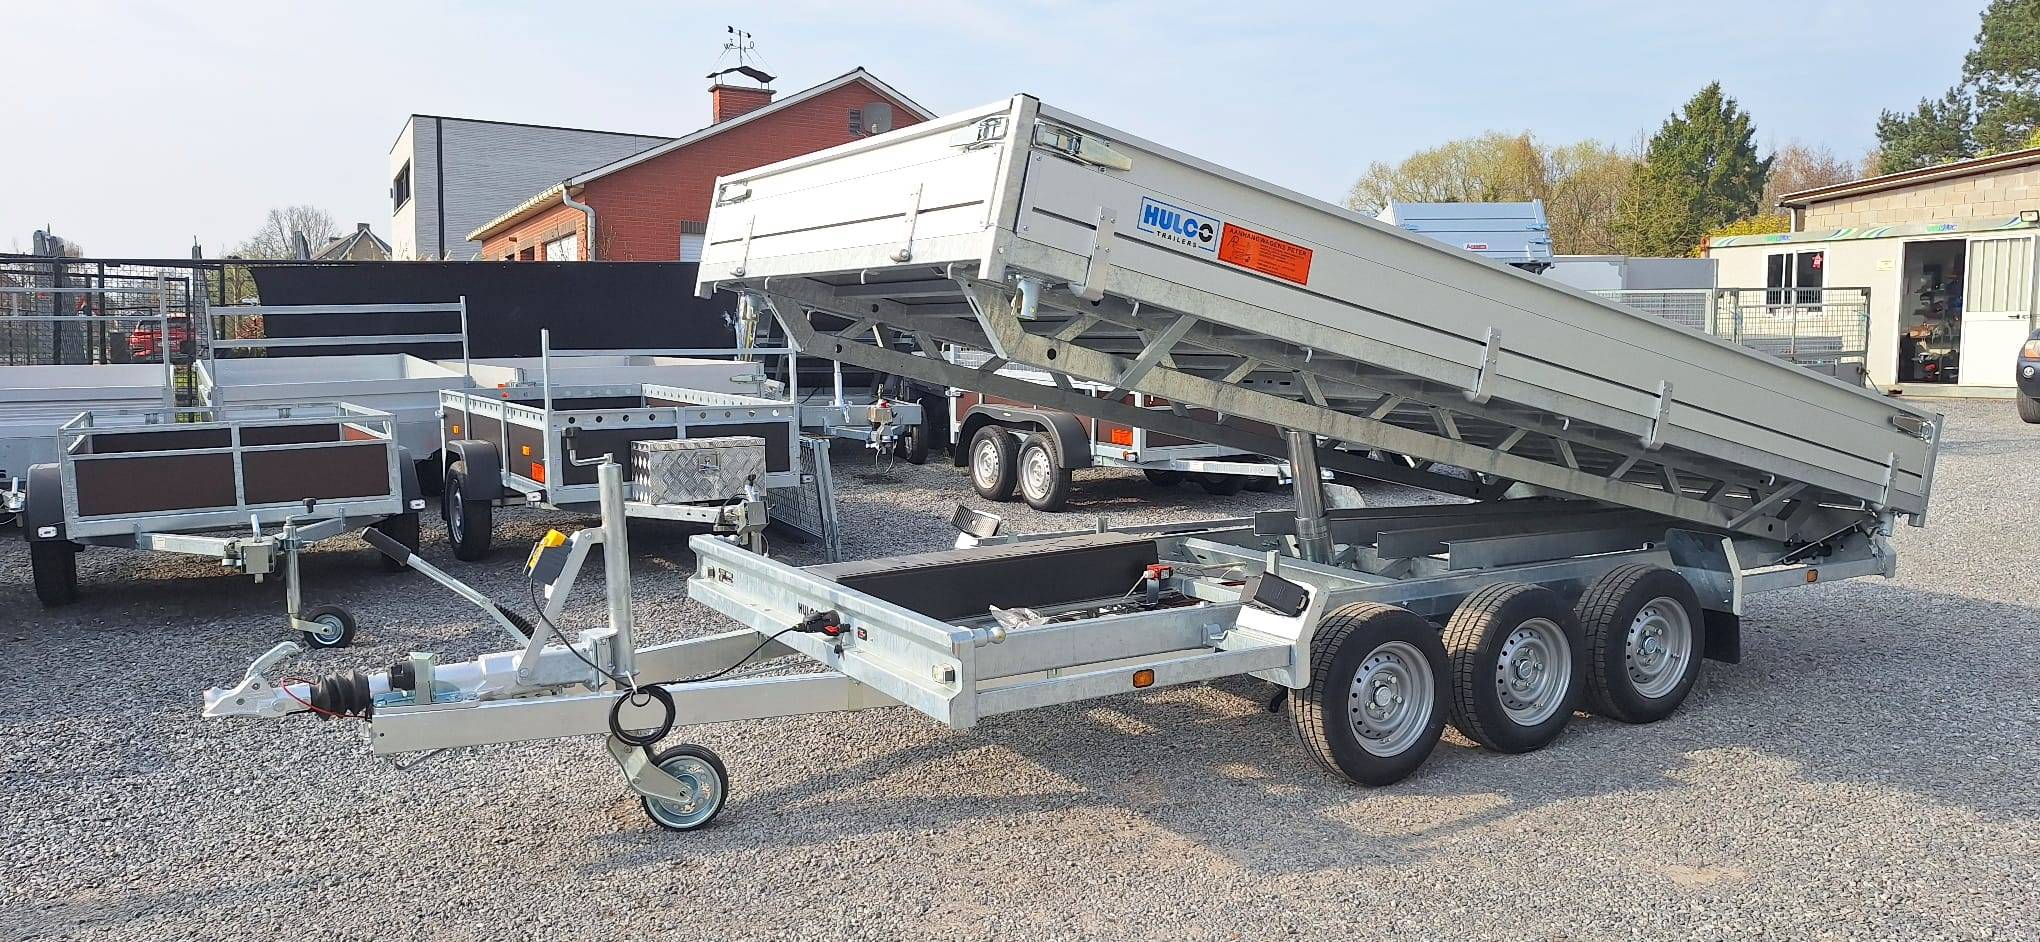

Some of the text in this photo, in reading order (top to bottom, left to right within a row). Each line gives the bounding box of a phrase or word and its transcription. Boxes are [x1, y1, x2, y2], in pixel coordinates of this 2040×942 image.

[1144, 204, 1213, 242] HULCO
[1157, 231, 1197, 248] TRAILERS
[1230, 228, 1286, 251] AANHANGWAGENS
[1287, 246, 1307, 255] PETER
